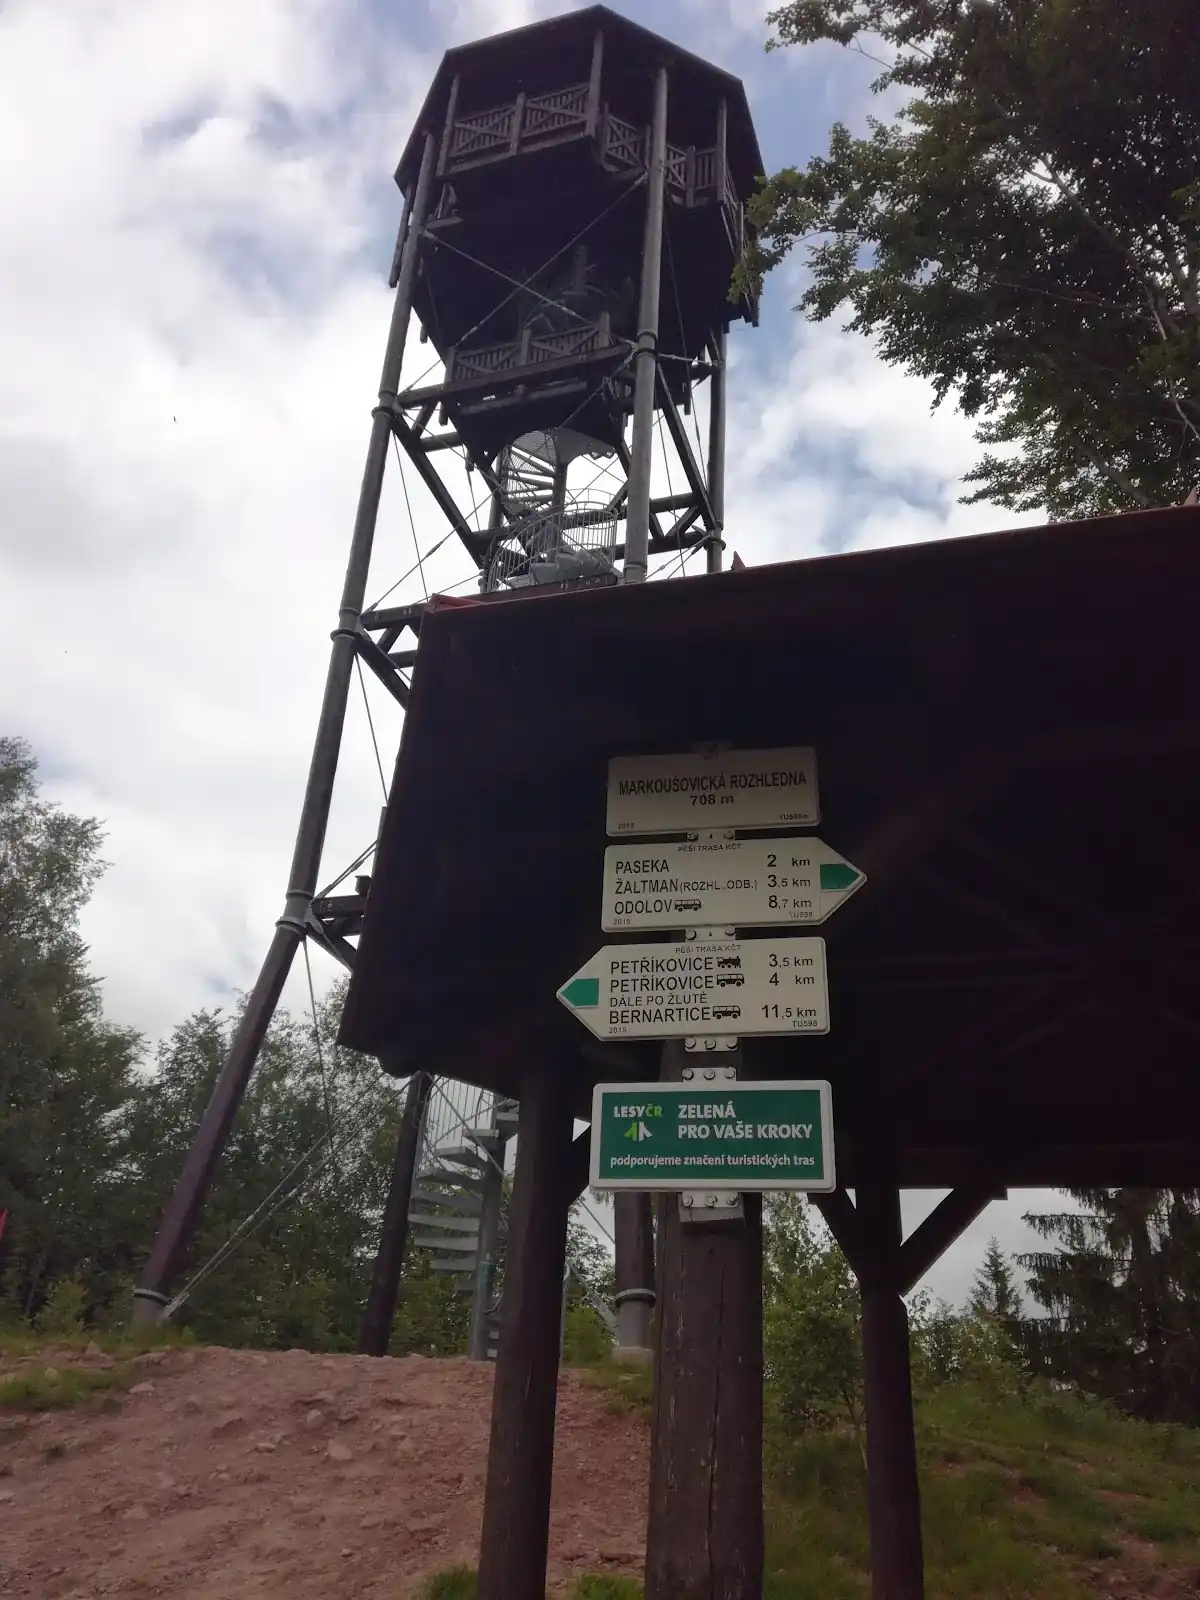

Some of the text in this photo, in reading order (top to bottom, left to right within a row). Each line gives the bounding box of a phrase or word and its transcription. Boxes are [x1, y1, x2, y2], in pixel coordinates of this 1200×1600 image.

[619, 771, 807, 796] MARKOUŠOVICKÁ ROZHLEDNA
[690, 794, 734, 806] 708 m
[697, 843, 724, 852] TRASA
[725, 842, 742, 851] KČT
[615, 854, 811, 874] PASEKA 2 km
[767, 874, 788, 888] 3,5
[792, 877, 811, 887] km
[614, 895, 812, 915] ODOLOV 8,7 km
[696, 945, 723, 953] TRASA
[724, 944, 742, 952] KČT
[610, 953, 814, 975] PETŘÍKOVICE 3,5 km
[610, 972, 815, 993] PETŘÍKOVICE 4 km
[609, 993, 708, 1008] DÁLE PO ŽLUTÉ
[609, 1004, 817, 1025] BERNARTICE 11,5 km
[609, 1026, 627, 1034] 2015
[678, 1100, 737, 1119] ZELENÁ
[678, 1121, 813, 1140] PRO VAŠE KROKY
[610, 1154, 815, 1169] podporujeme značení turistických tras
